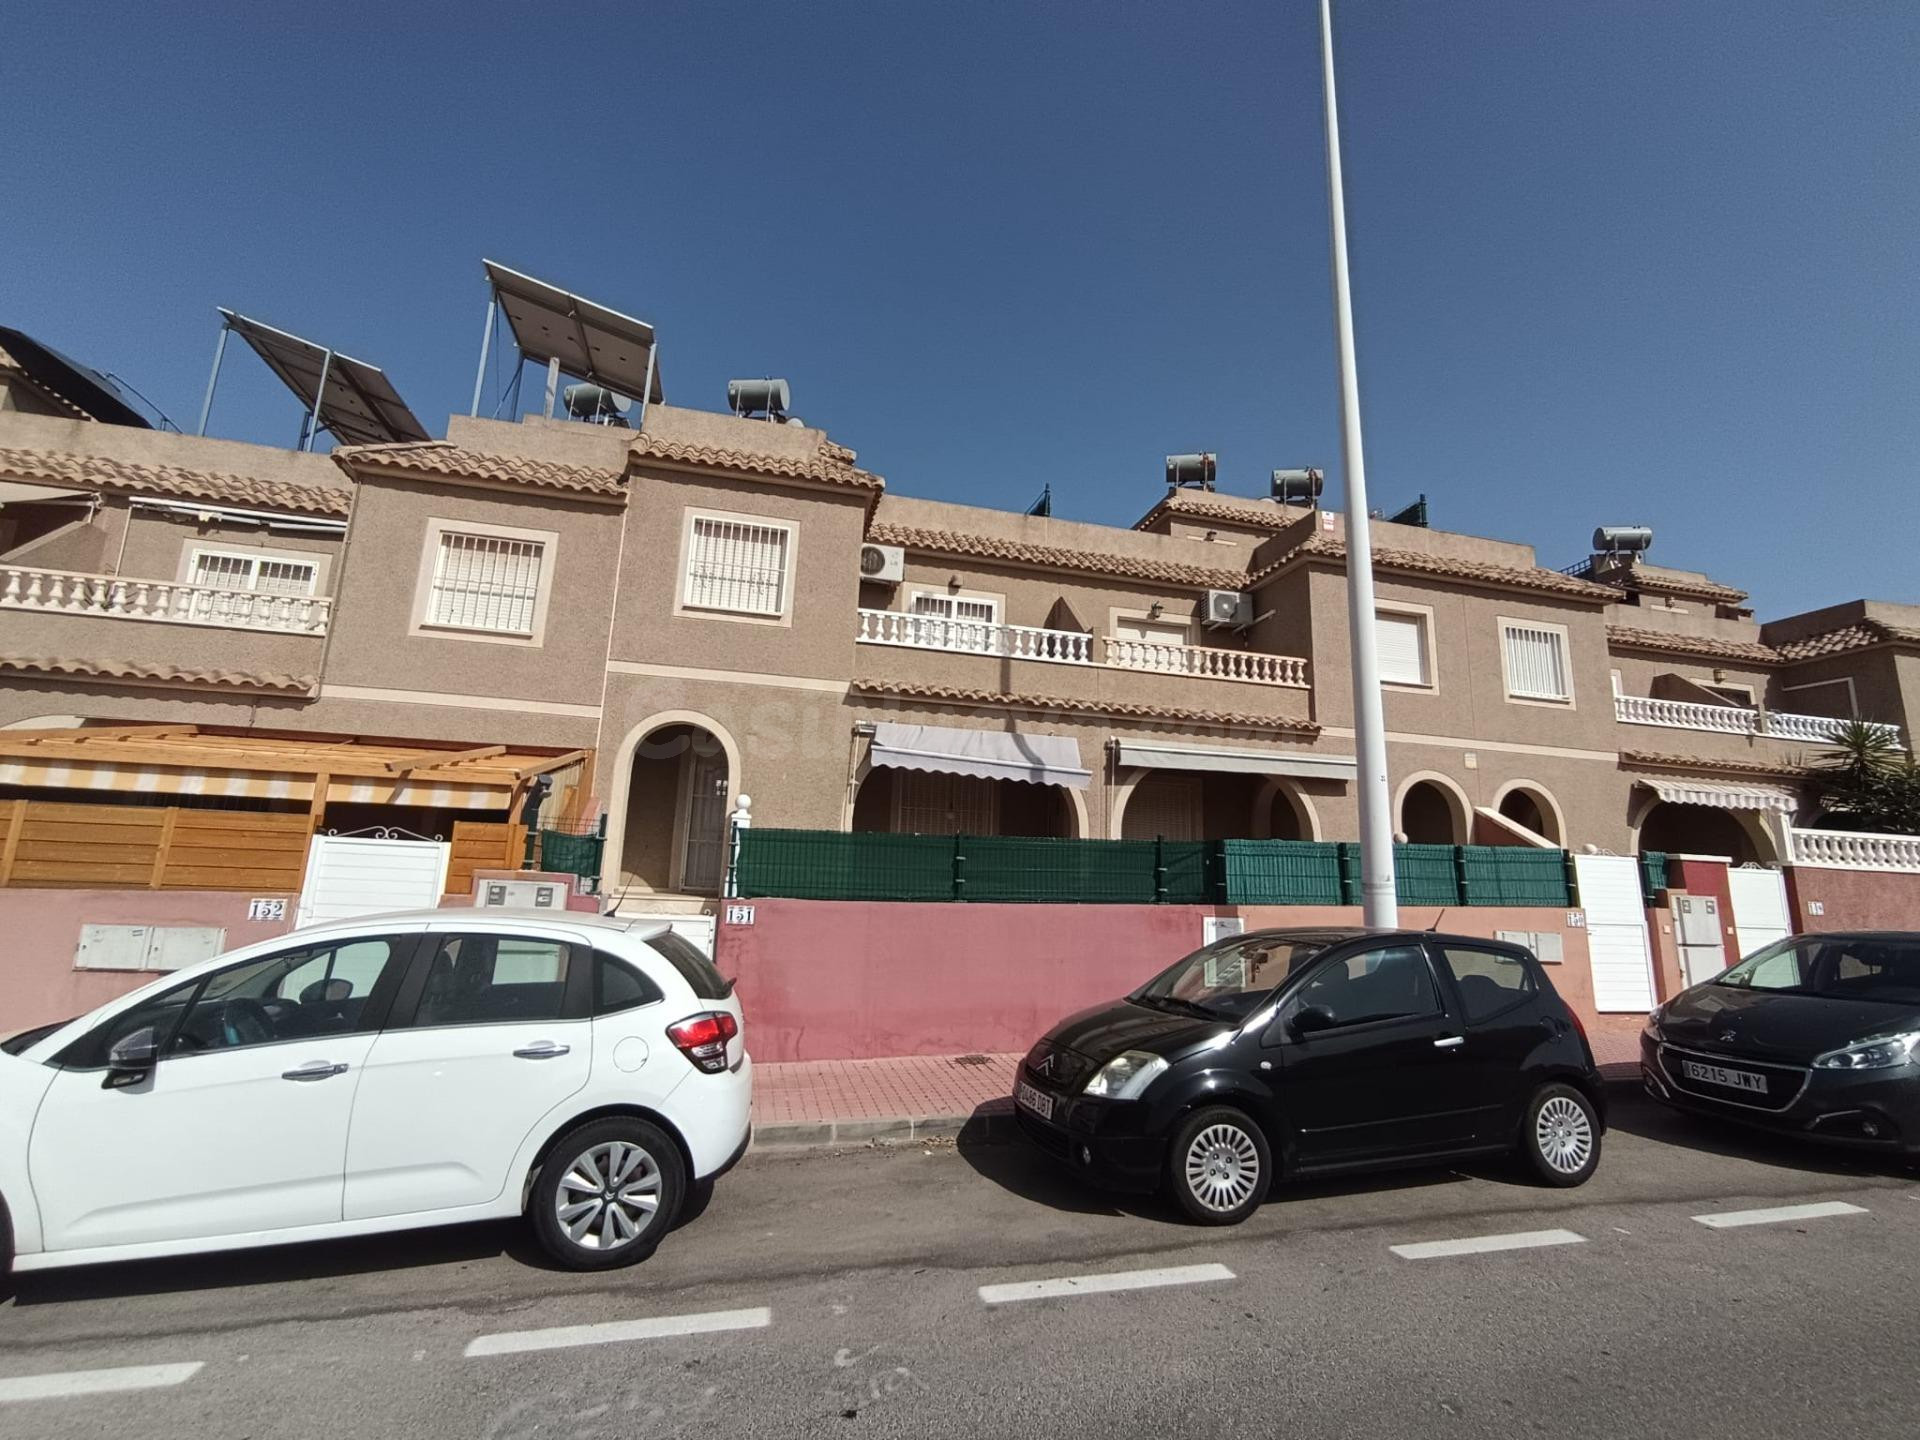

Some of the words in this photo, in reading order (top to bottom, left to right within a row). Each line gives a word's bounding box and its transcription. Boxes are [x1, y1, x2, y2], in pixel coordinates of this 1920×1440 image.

[252, 903, 283, 917] 152
[729, 909, 752, 921] 151
[1691, 1064, 1728, 1083] 6215
[1734, 1072, 1761, 1089] JWY
